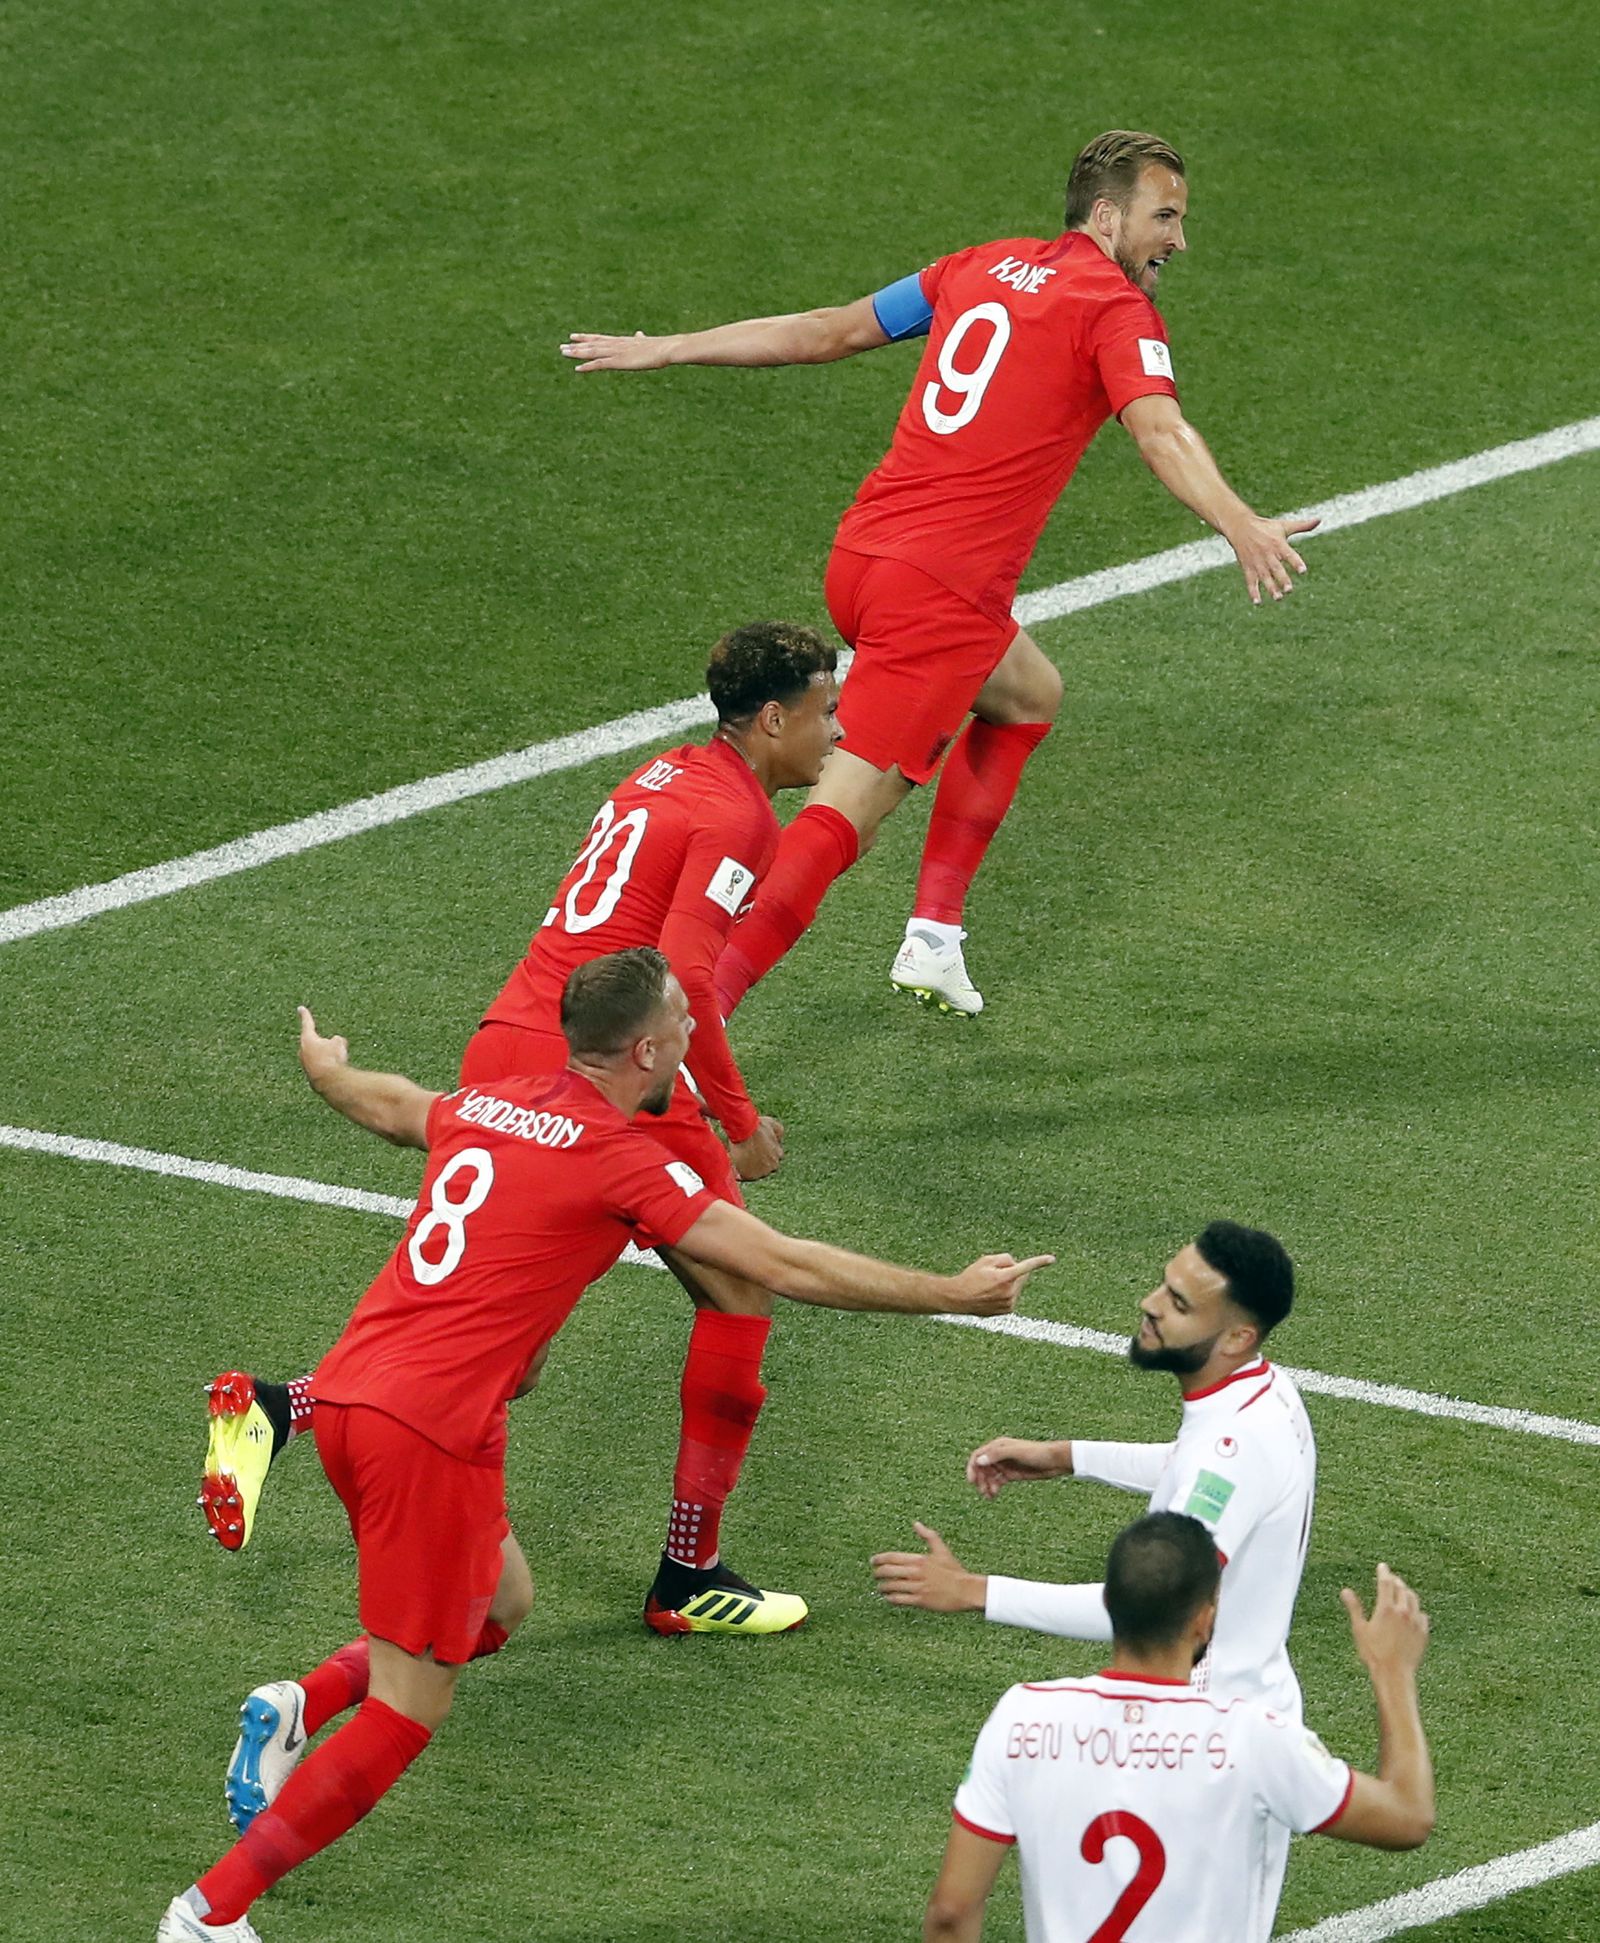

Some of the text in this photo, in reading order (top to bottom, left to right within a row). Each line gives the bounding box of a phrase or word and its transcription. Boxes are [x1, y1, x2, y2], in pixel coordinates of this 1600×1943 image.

[987, 256, 1057, 294] KANE
[922, 301, 1011, 435] 9
[634, 759, 684, 791] DELE
[542, 799, 649, 934] 20
[455, 1088, 585, 1149] HENDERSON
[408, 1147, 495, 1286] 8
[1006, 1722, 1235, 1770] BEN YOUSSEF S.
[1080, 1809, 1166, 1943] 2
